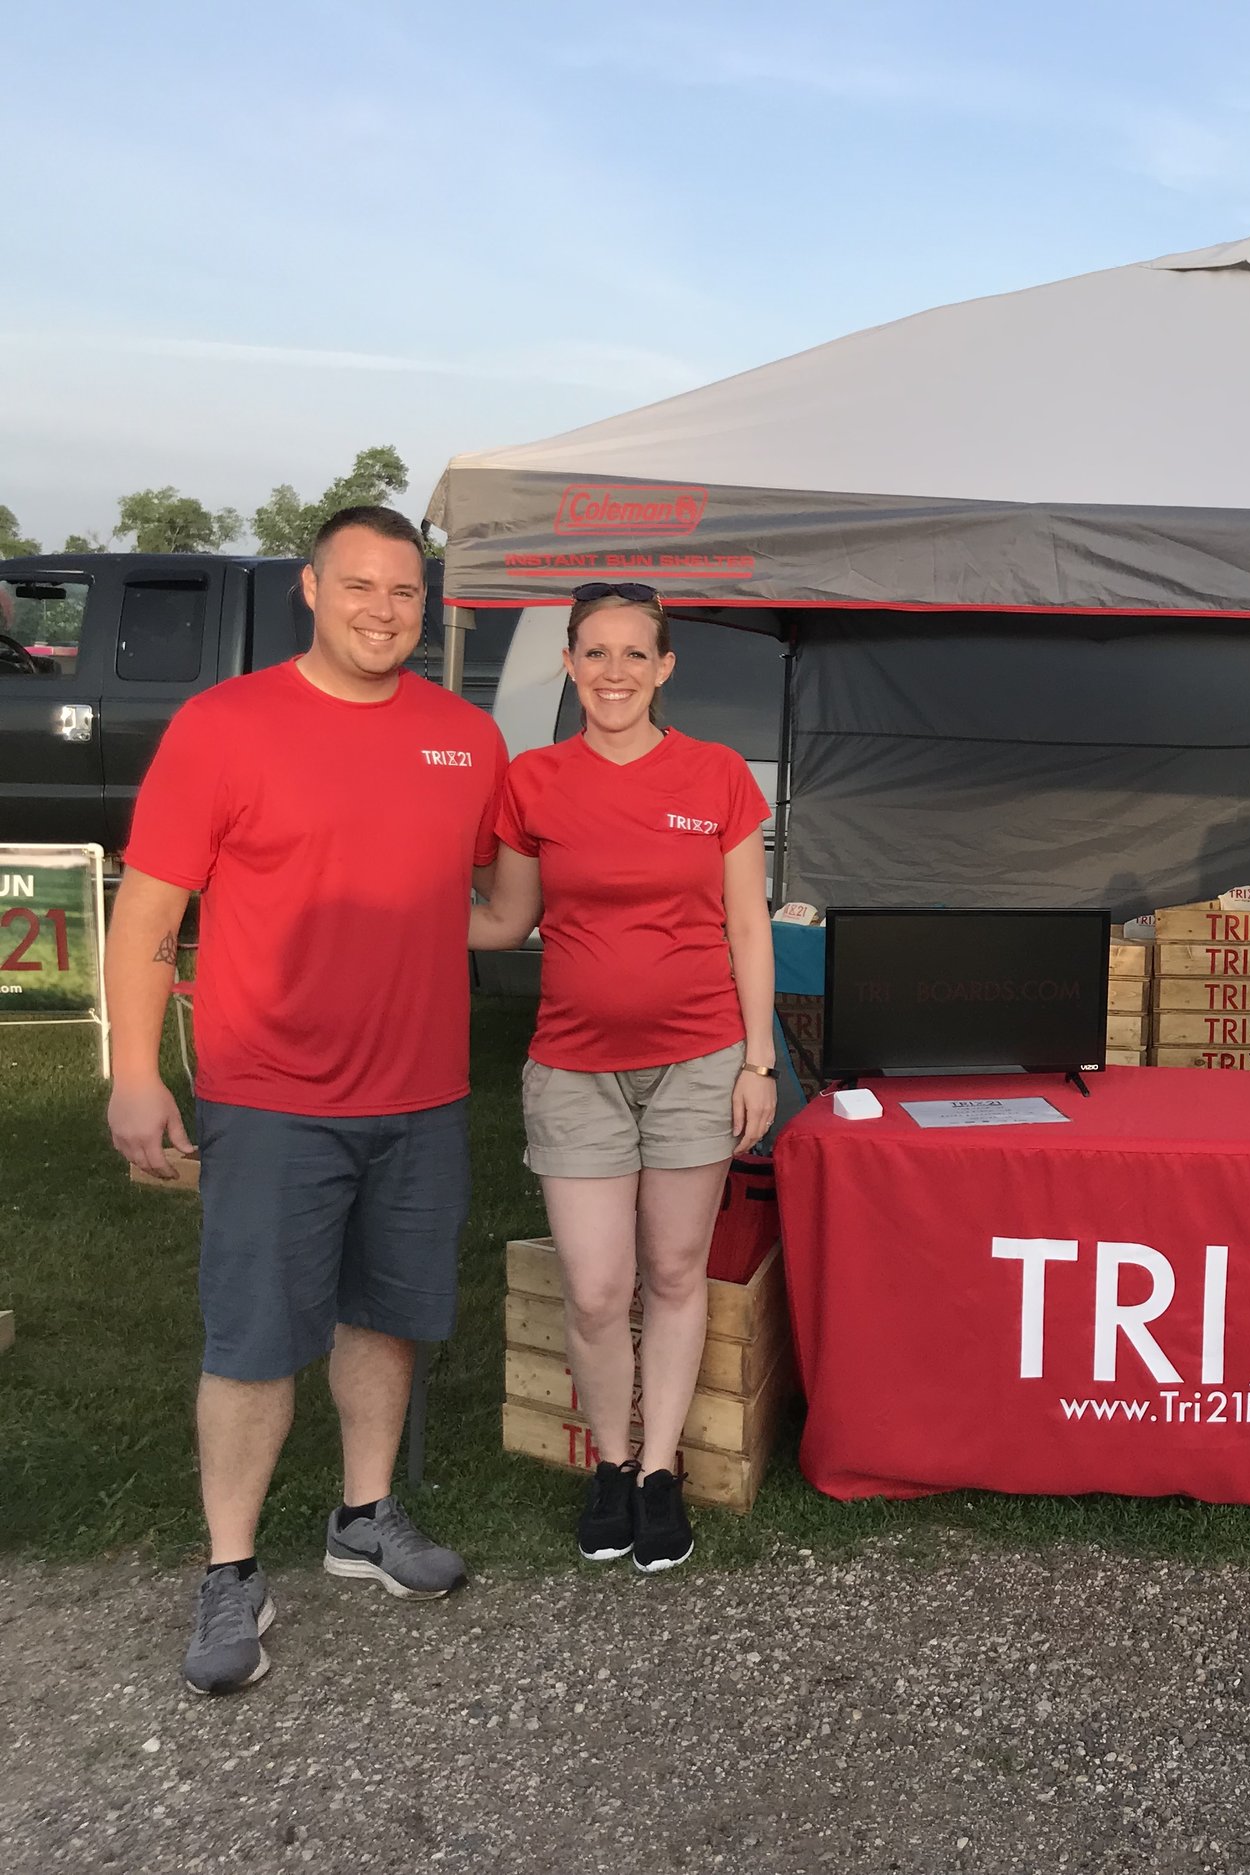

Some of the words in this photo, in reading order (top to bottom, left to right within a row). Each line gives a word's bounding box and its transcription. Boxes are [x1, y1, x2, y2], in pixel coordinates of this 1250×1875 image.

[569, 492, 673, 523] Coleman
[504, 553, 598, 567] INSTANT
[606, 554, 652, 567] SUN
[659, 554, 755, 568] SHELTER
